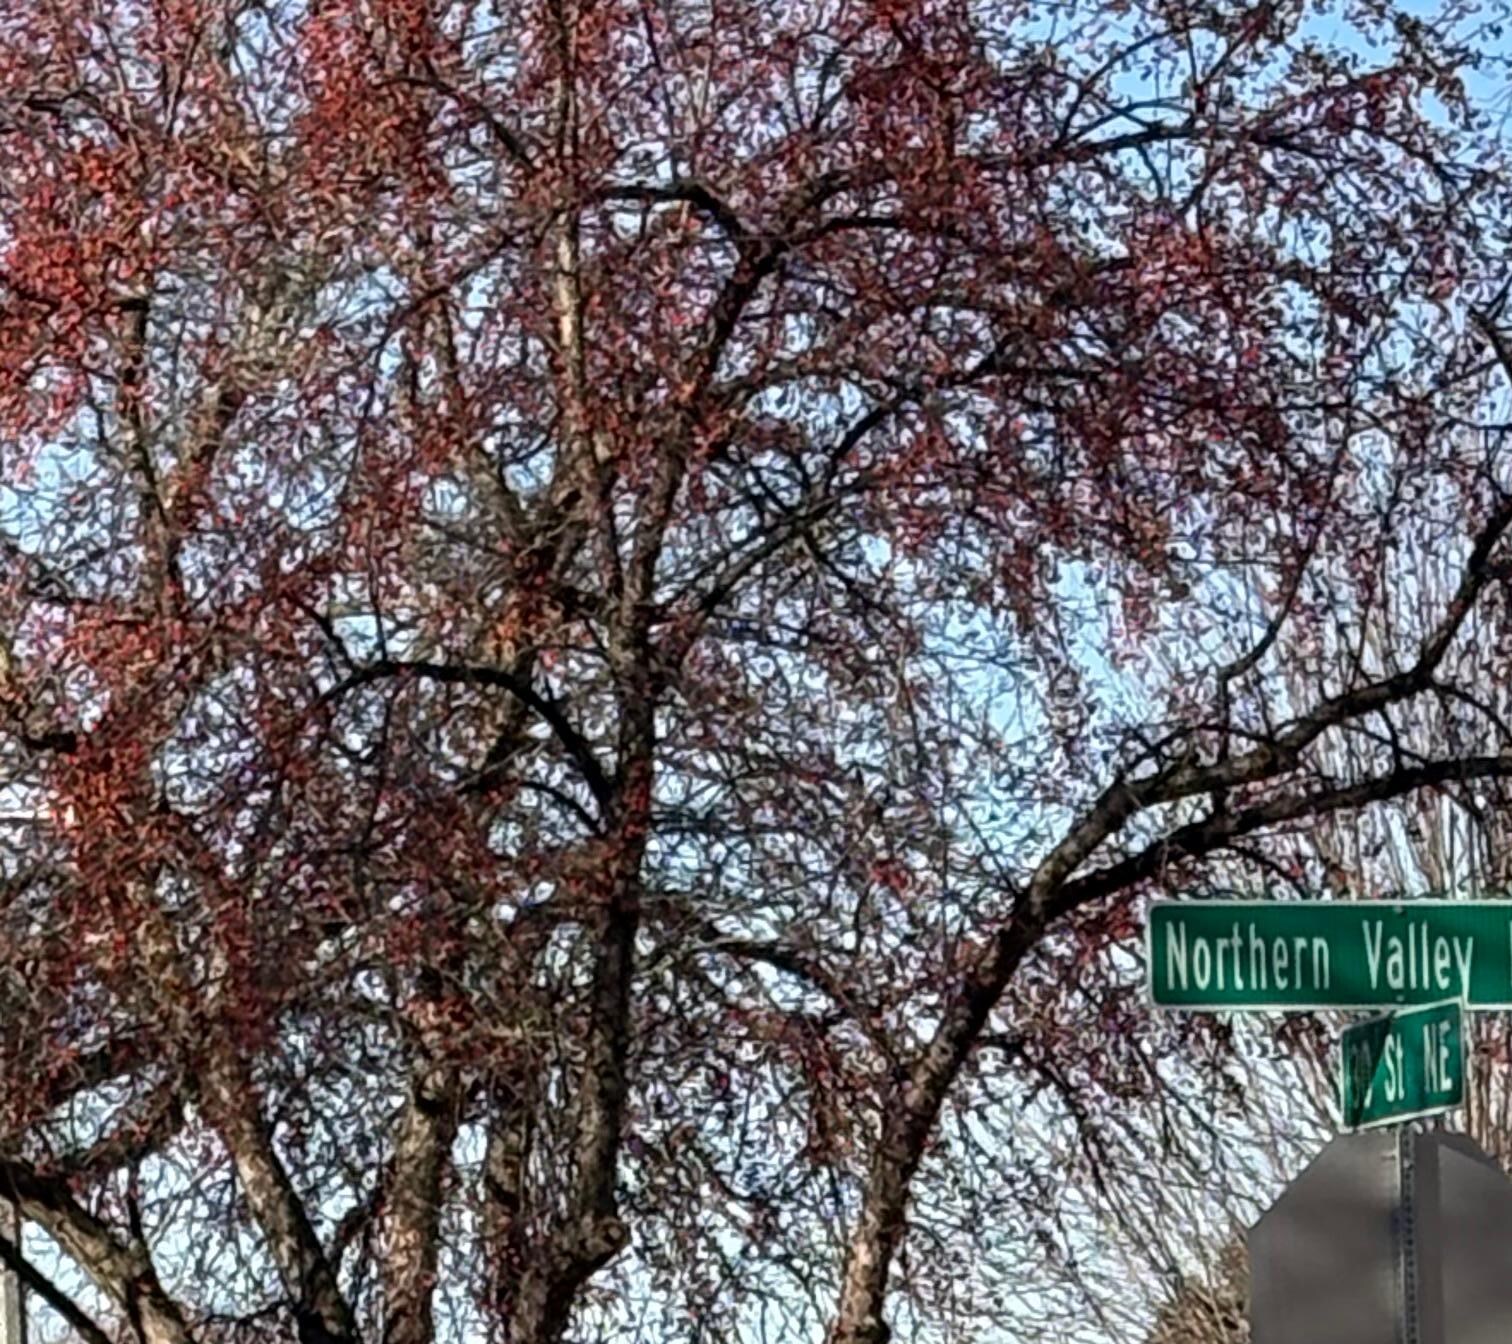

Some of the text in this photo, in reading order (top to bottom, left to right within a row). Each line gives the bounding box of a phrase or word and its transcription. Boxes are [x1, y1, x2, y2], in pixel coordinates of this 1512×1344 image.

[1165, 920, 1330, 991] Northern
[1362, 919, 1474, 998] Valley
[1383, 1031, 1406, 1104] St
[1422, 1018, 1454, 1096] NE
